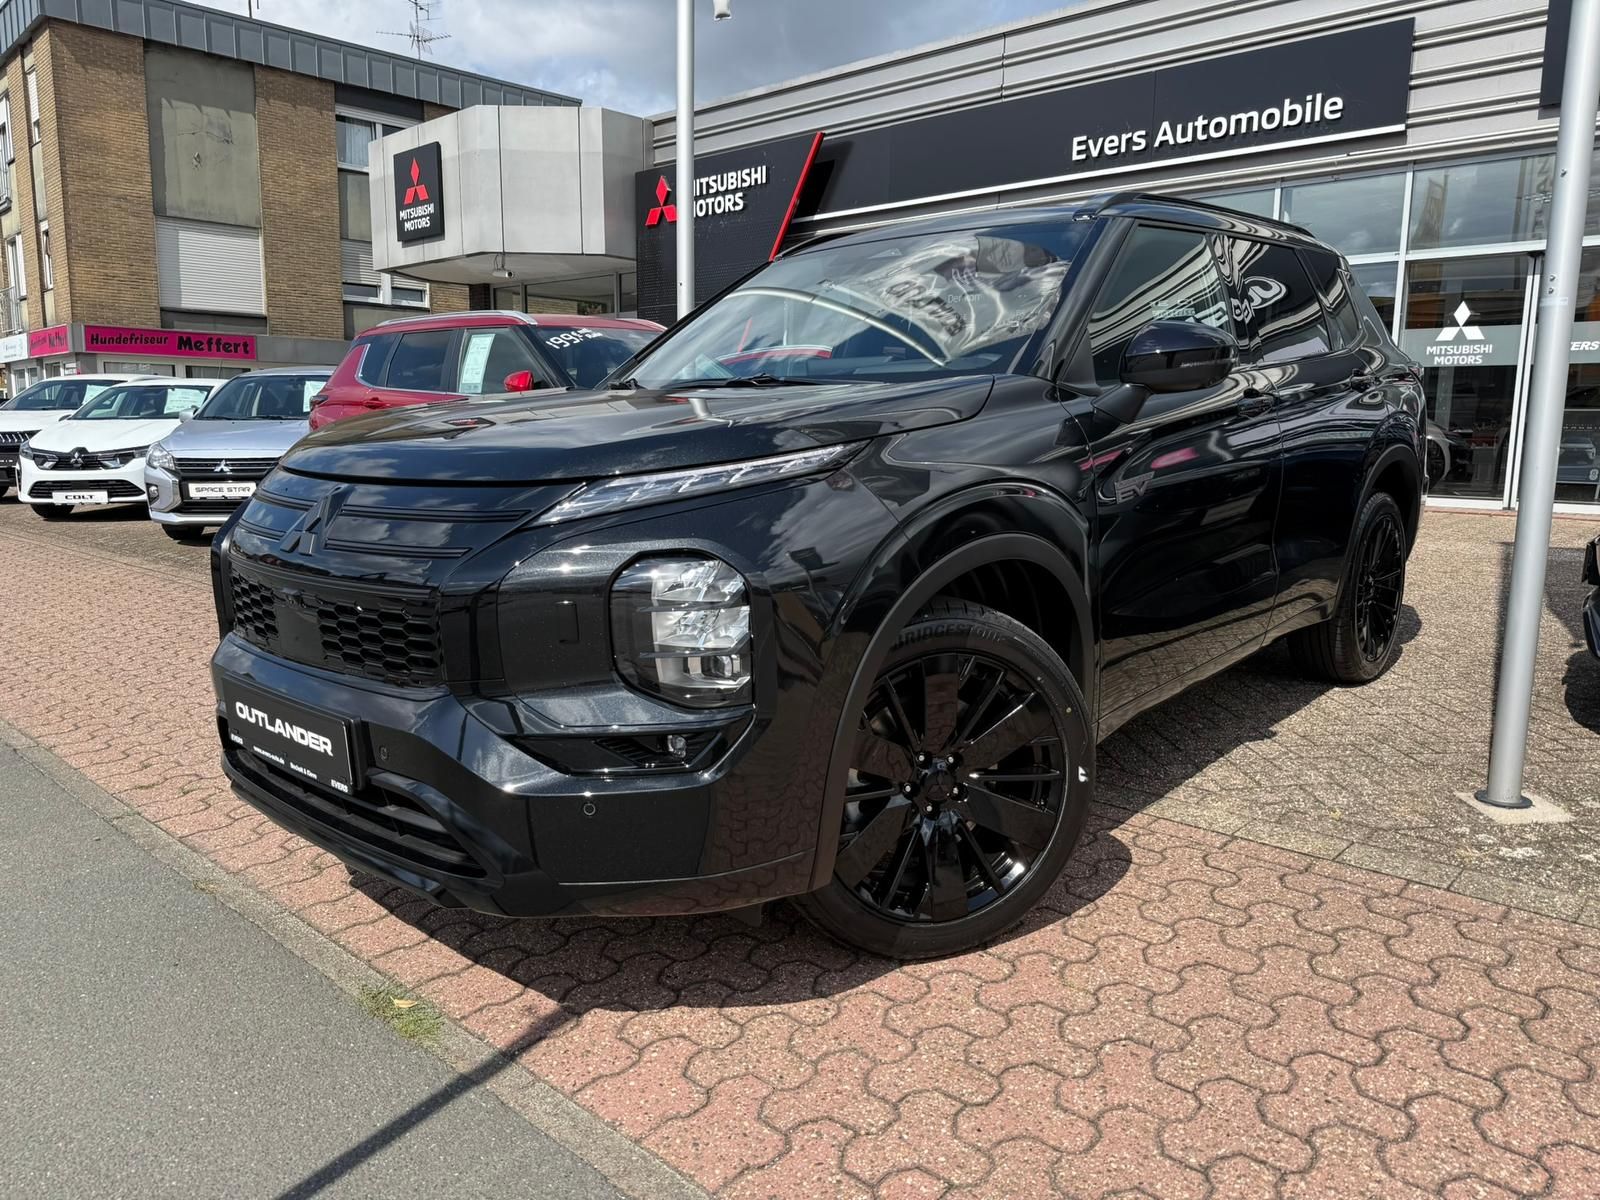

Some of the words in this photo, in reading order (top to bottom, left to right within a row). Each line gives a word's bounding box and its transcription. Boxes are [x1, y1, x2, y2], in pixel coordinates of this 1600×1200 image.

[1072, 129, 1147, 161] Evers
[1154, 92, 1344, 148] Automobile
[693, 165, 767, 197] ITSUBISHI
[400, 202, 435, 221] MITSUBISHI
[693, 192, 744, 218] OTORS
[404, 216, 431, 232] MOTORS
[90, 332, 169, 346] Hundefriseur
[177, 335, 250, 355] Meffert
[1425, 343, 1493, 355] MITSUBISHI
[1433, 354, 1483, 365] MOTORS
[194, 485, 224, 493] SPACE
[226, 485, 252, 493] STAR
[235, 701, 334, 757] OUTLANDER
